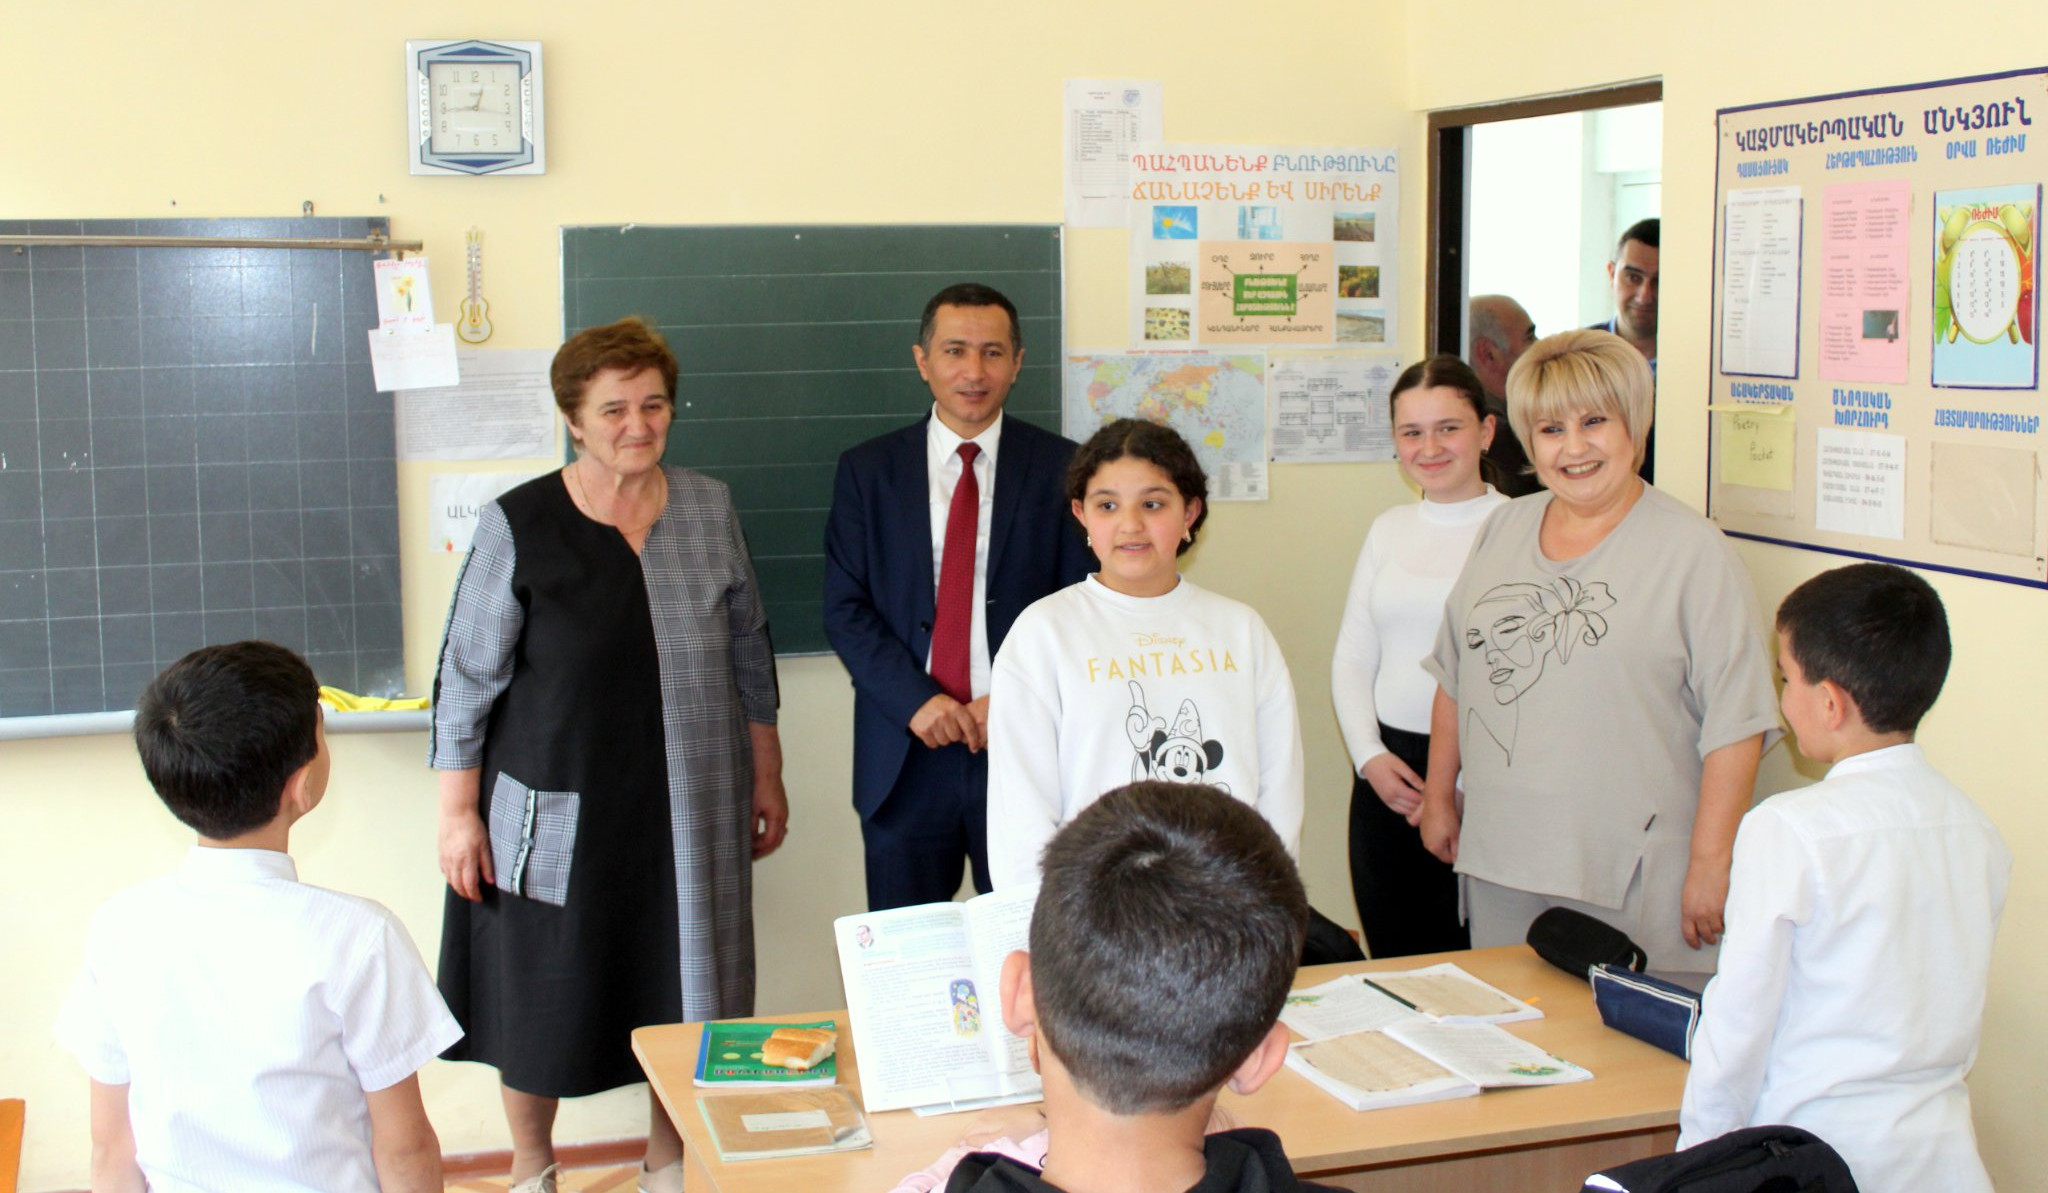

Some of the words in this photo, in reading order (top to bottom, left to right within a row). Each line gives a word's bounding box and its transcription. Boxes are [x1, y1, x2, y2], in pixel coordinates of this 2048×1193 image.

[1736, 111, 1904, 152] ԿԱԶՄԱԿԵՐՊԱԿԱՆ
[1923, 96, 2032, 135] ԱՆԿՅՈՒՆ
[1825, 145, 1918, 170] ՀԵՐԹԱՊԱՀՈՒԹՅՈՒՆ
[1946, 140, 1977, 160] ՕՐՎԱ
[1986, 133, 2026, 156] ՌԵԺԻՄ
[1132, 154, 1268, 172] ՊԱՀՊԱՆԵՆՔ
[1272, 154, 1396, 173] ԲՆՈՒԹՅՈՒՆԸ
[1132, 181, 1260, 200] ՃԱՆԱՉԵՆՔ
[1266, 180, 1294, 201] ԵՎ
[1304, 181, 1382, 201] ՍԻՐԵՆՔ
[1832, 388, 1892, 410] ԾՆՈՂԱԿԱՆ
[1834, 409, 1889, 429] ԽՈՐՀՈՒՐԴ
[1934, 409, 2040, 434] ՀԱՅՏԱՐԱՐՈՒԹՅՈՒՆՆԵՐ
[1130, 631, 1186, 648] Disney
[1087, 648, 1238, 683] FANTASIA
